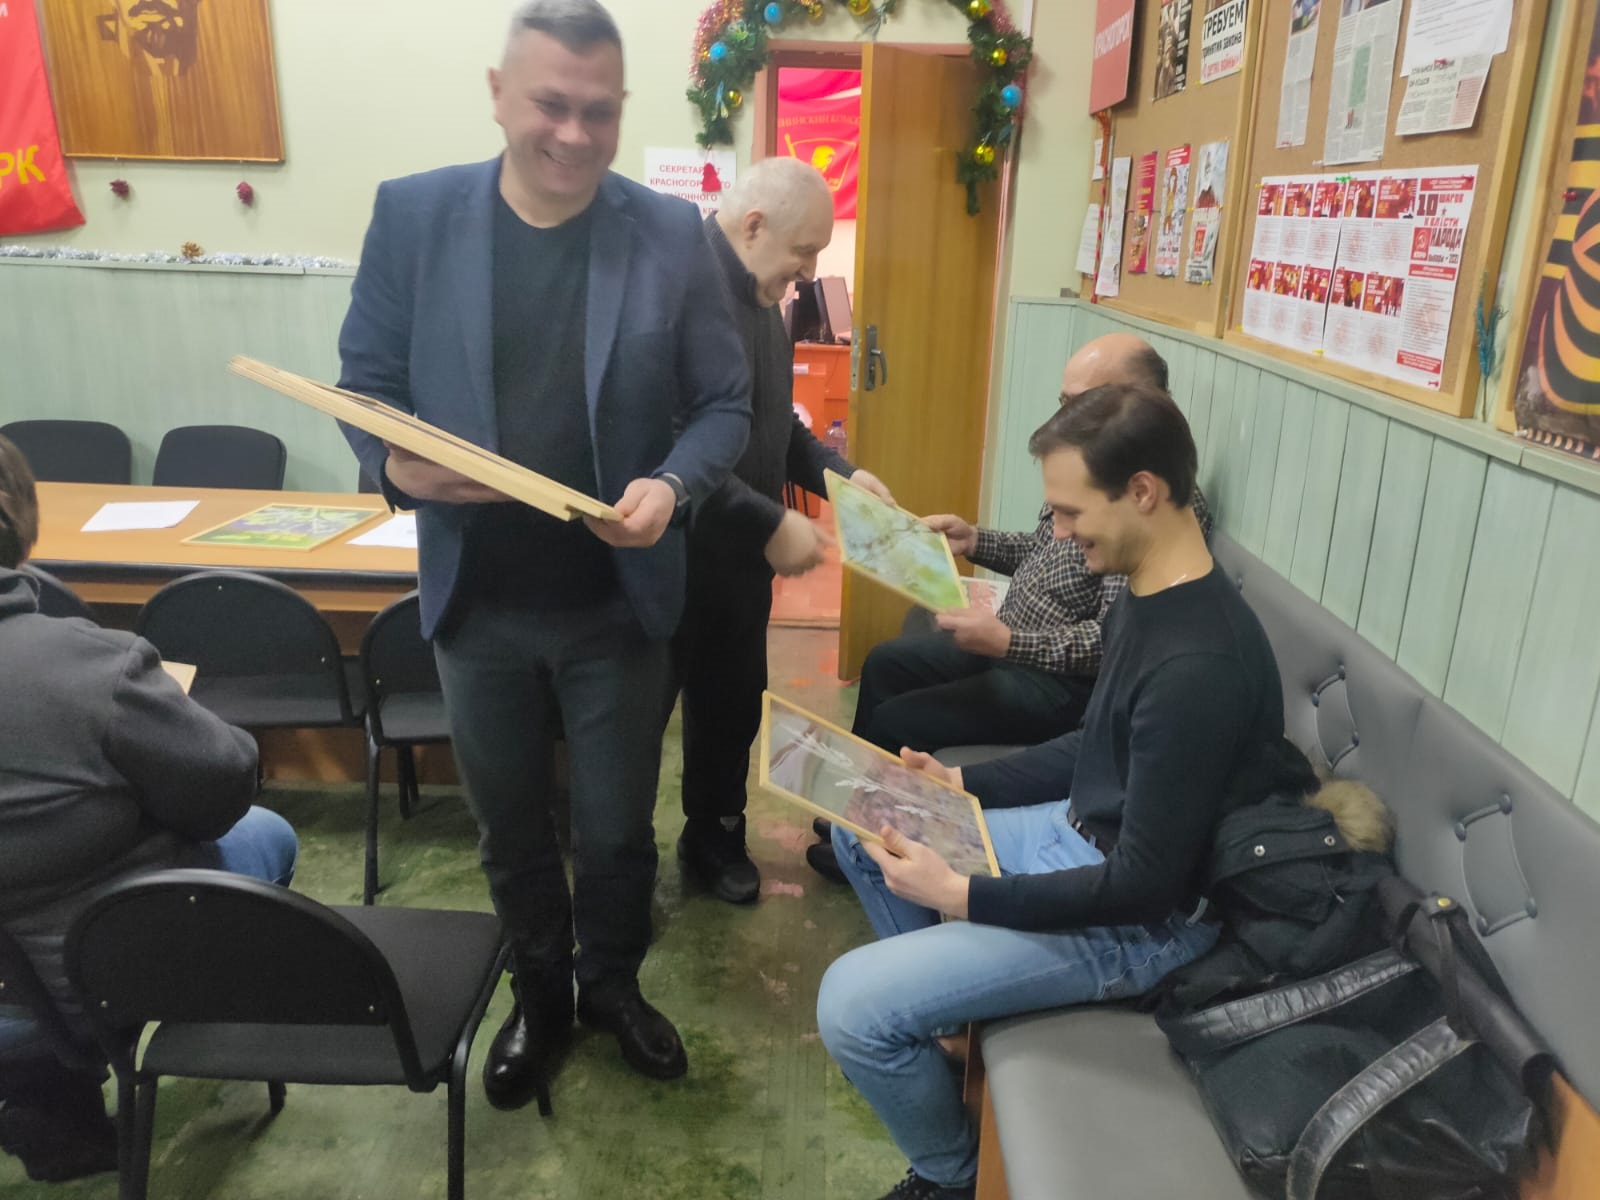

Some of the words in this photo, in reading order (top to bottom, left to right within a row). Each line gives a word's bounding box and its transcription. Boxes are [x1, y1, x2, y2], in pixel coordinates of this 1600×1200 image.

[1203, 2, 1244, 41] ТРЕБУЕМ
[659, 164, 722, 175] СЕКРЕТАРТ
[1417, 194, 1438, 216] 10
[1439, 194, 1463, 203] ШАГОВ
[1430, 217, 1459, 227] ВЛАСТИ
[1430, 228, 1463, 250] НАРОДА
